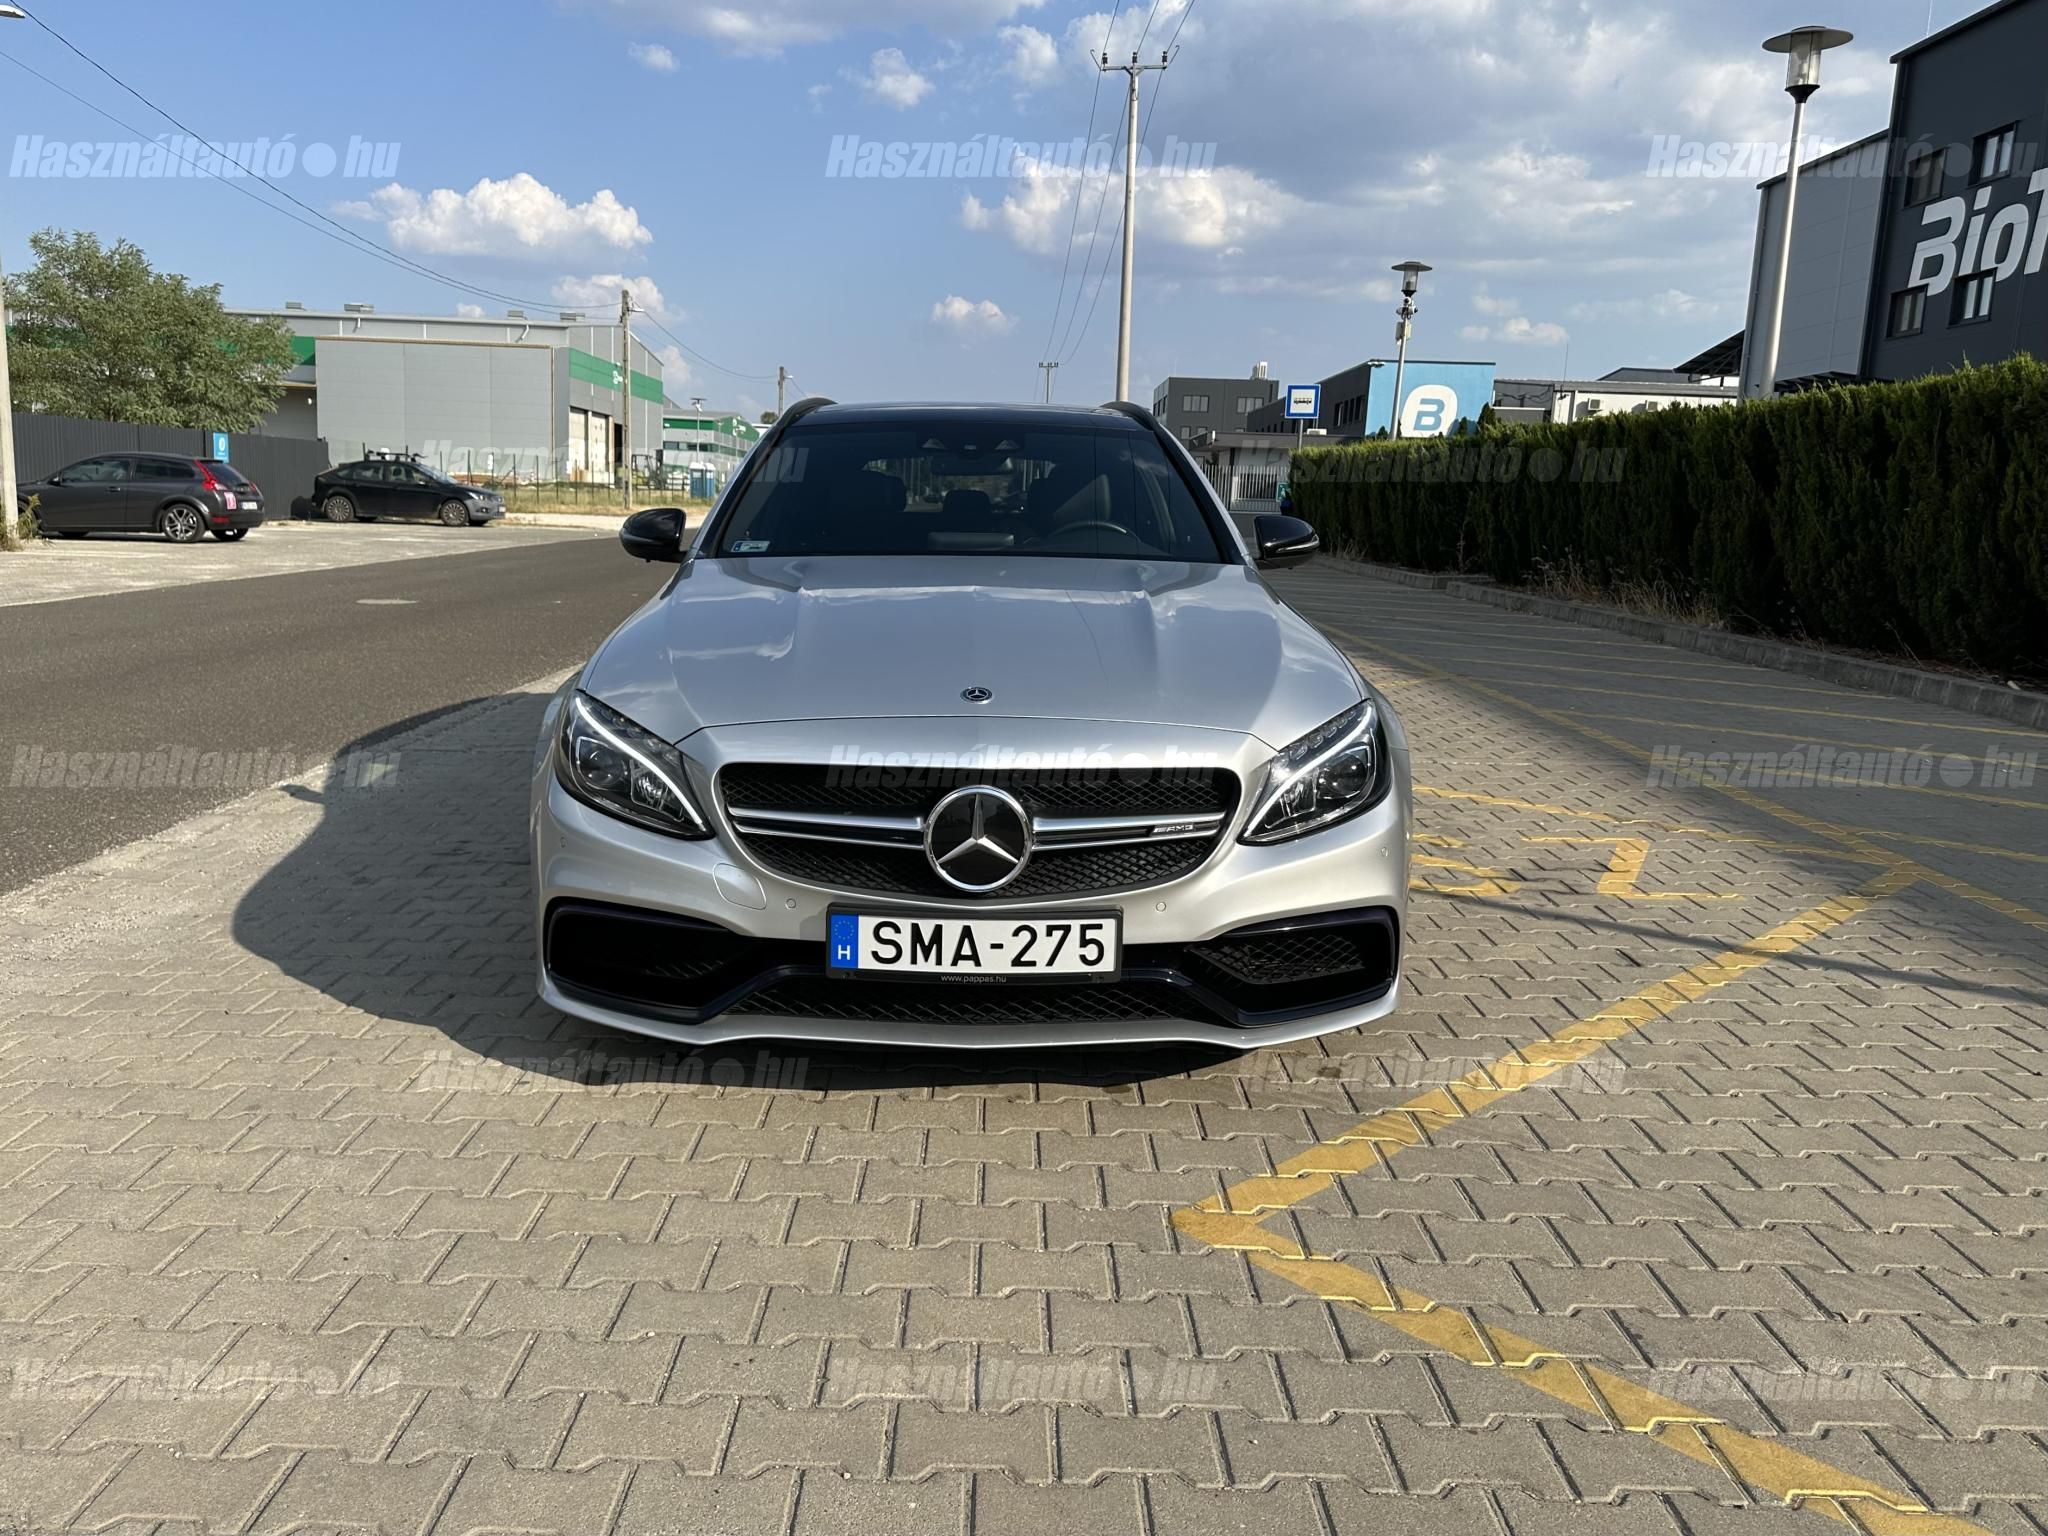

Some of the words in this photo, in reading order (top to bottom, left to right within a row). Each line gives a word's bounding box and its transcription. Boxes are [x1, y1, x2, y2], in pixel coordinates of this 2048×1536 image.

[870, 920, 1105, 968] SMA-275
[837, 945, 850, 960] H
[941, 975, 1007, 984] www.pappas.hu
